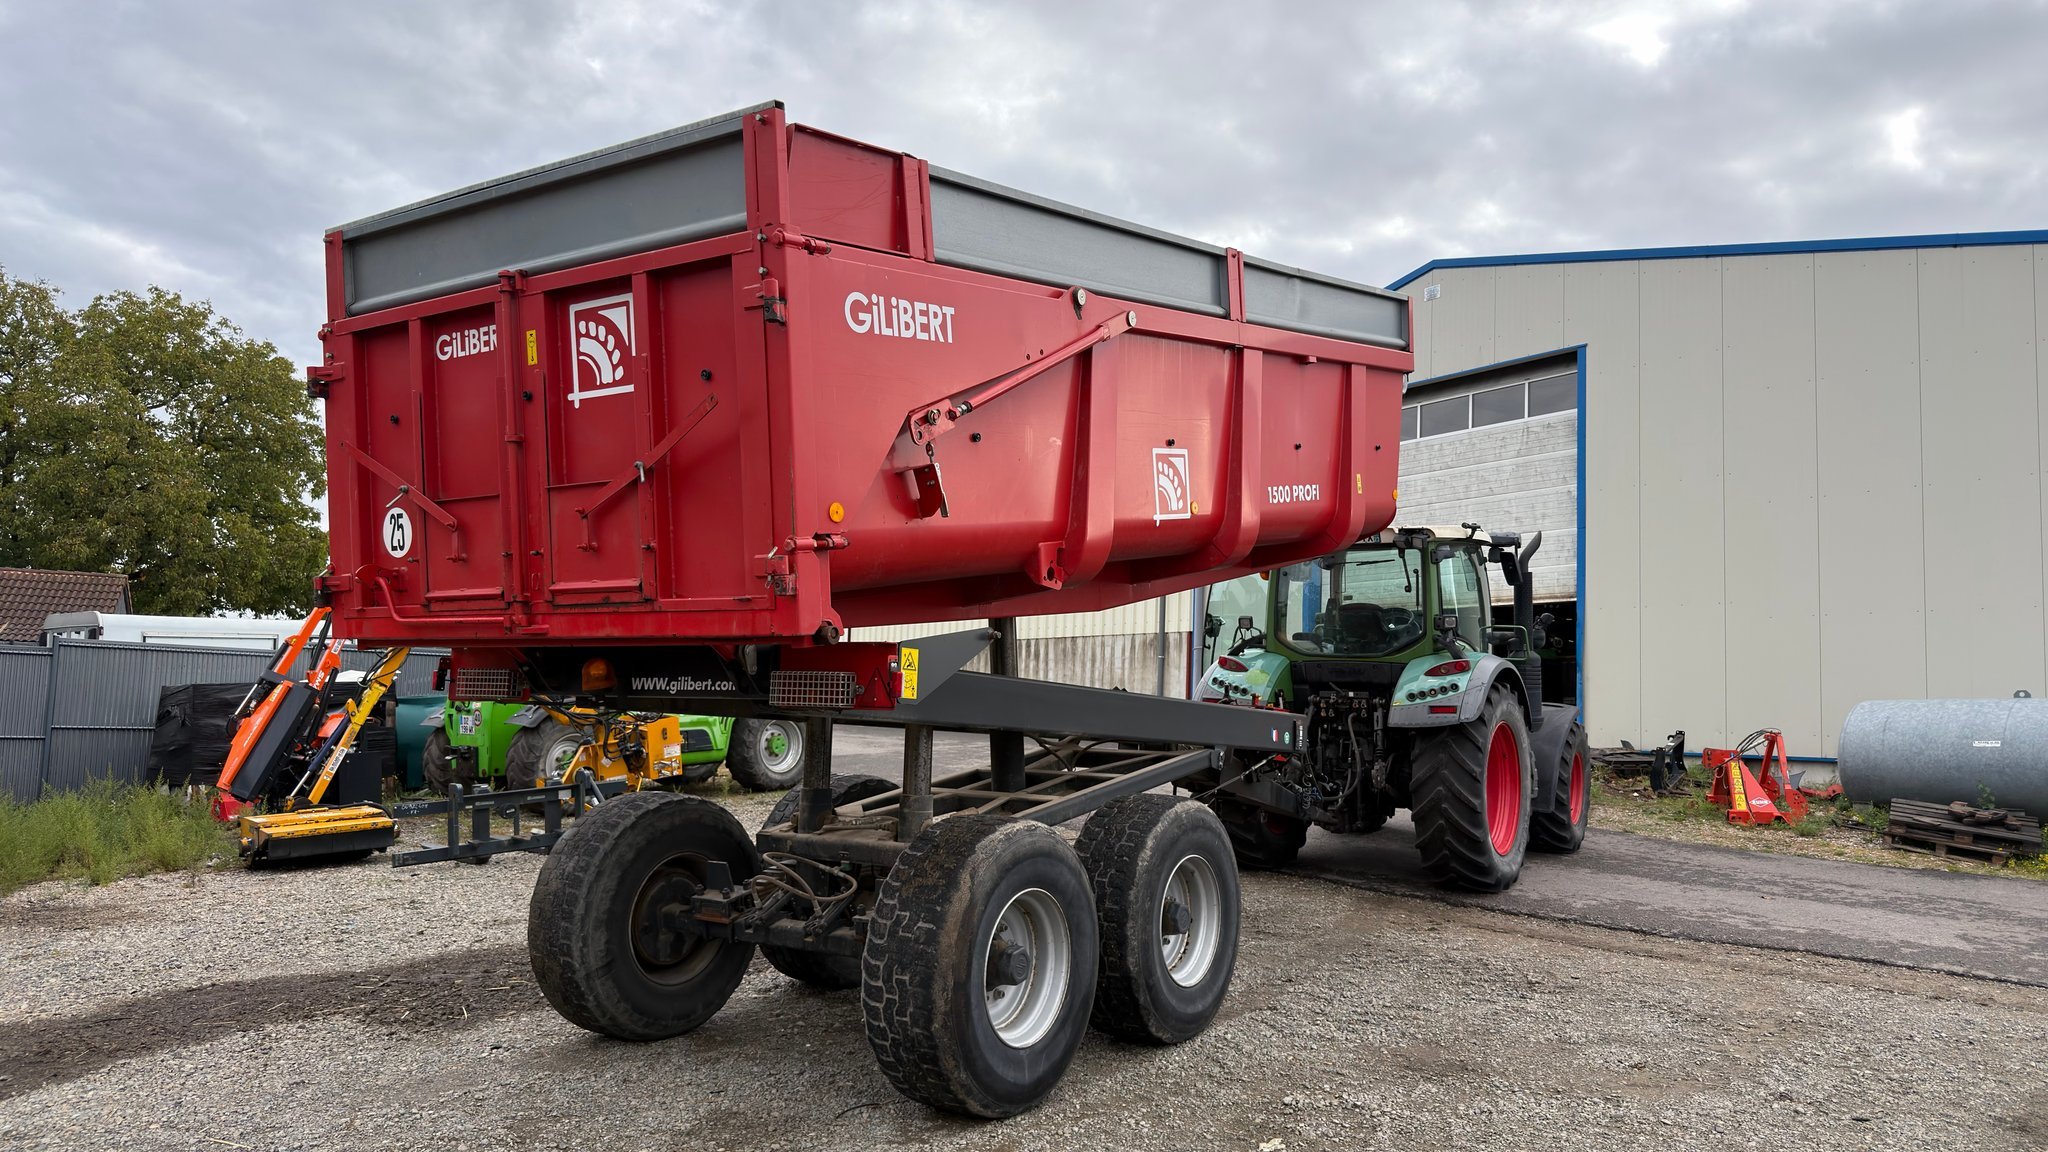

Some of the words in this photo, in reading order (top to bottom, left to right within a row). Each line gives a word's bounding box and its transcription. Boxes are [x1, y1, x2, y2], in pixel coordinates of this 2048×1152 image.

[845, 292, 954, 343] GiLiBERT
[435, 325, 498, 361] GiLiBER
[1267, 485, 1291, 504] 1500
[1292, 484, 1320, 502] PROFI
[390, 513, 405, 551] 25
